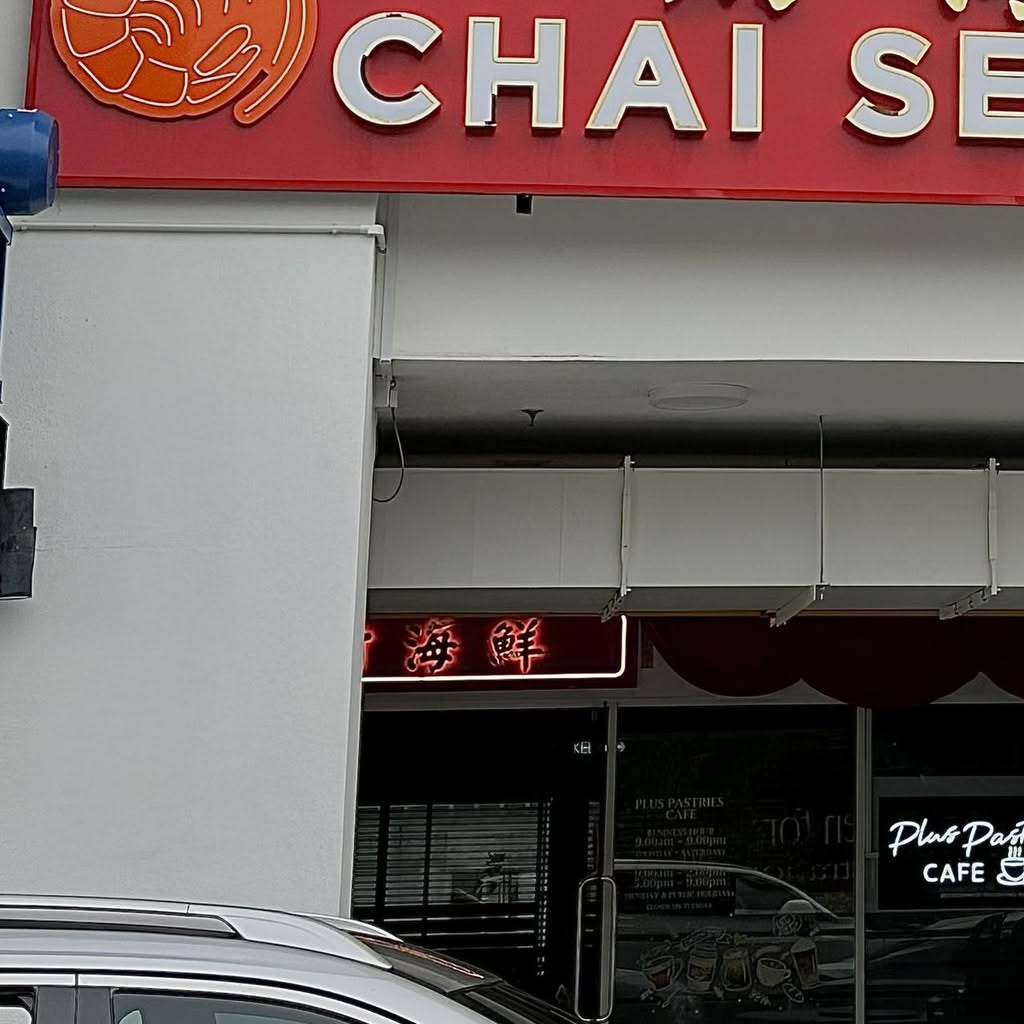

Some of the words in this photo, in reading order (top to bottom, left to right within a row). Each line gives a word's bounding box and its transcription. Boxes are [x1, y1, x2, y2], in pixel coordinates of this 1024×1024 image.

[332, 12, 765, 134] CHAI
[635, 798, 665, 810] PLUS
[667, 796, 725, 809] PASTRIES
[665, 808, 697, 820] CAFE
[888, 818, 961, 858] Plus
[922, 862, 985, 884] CAFE
